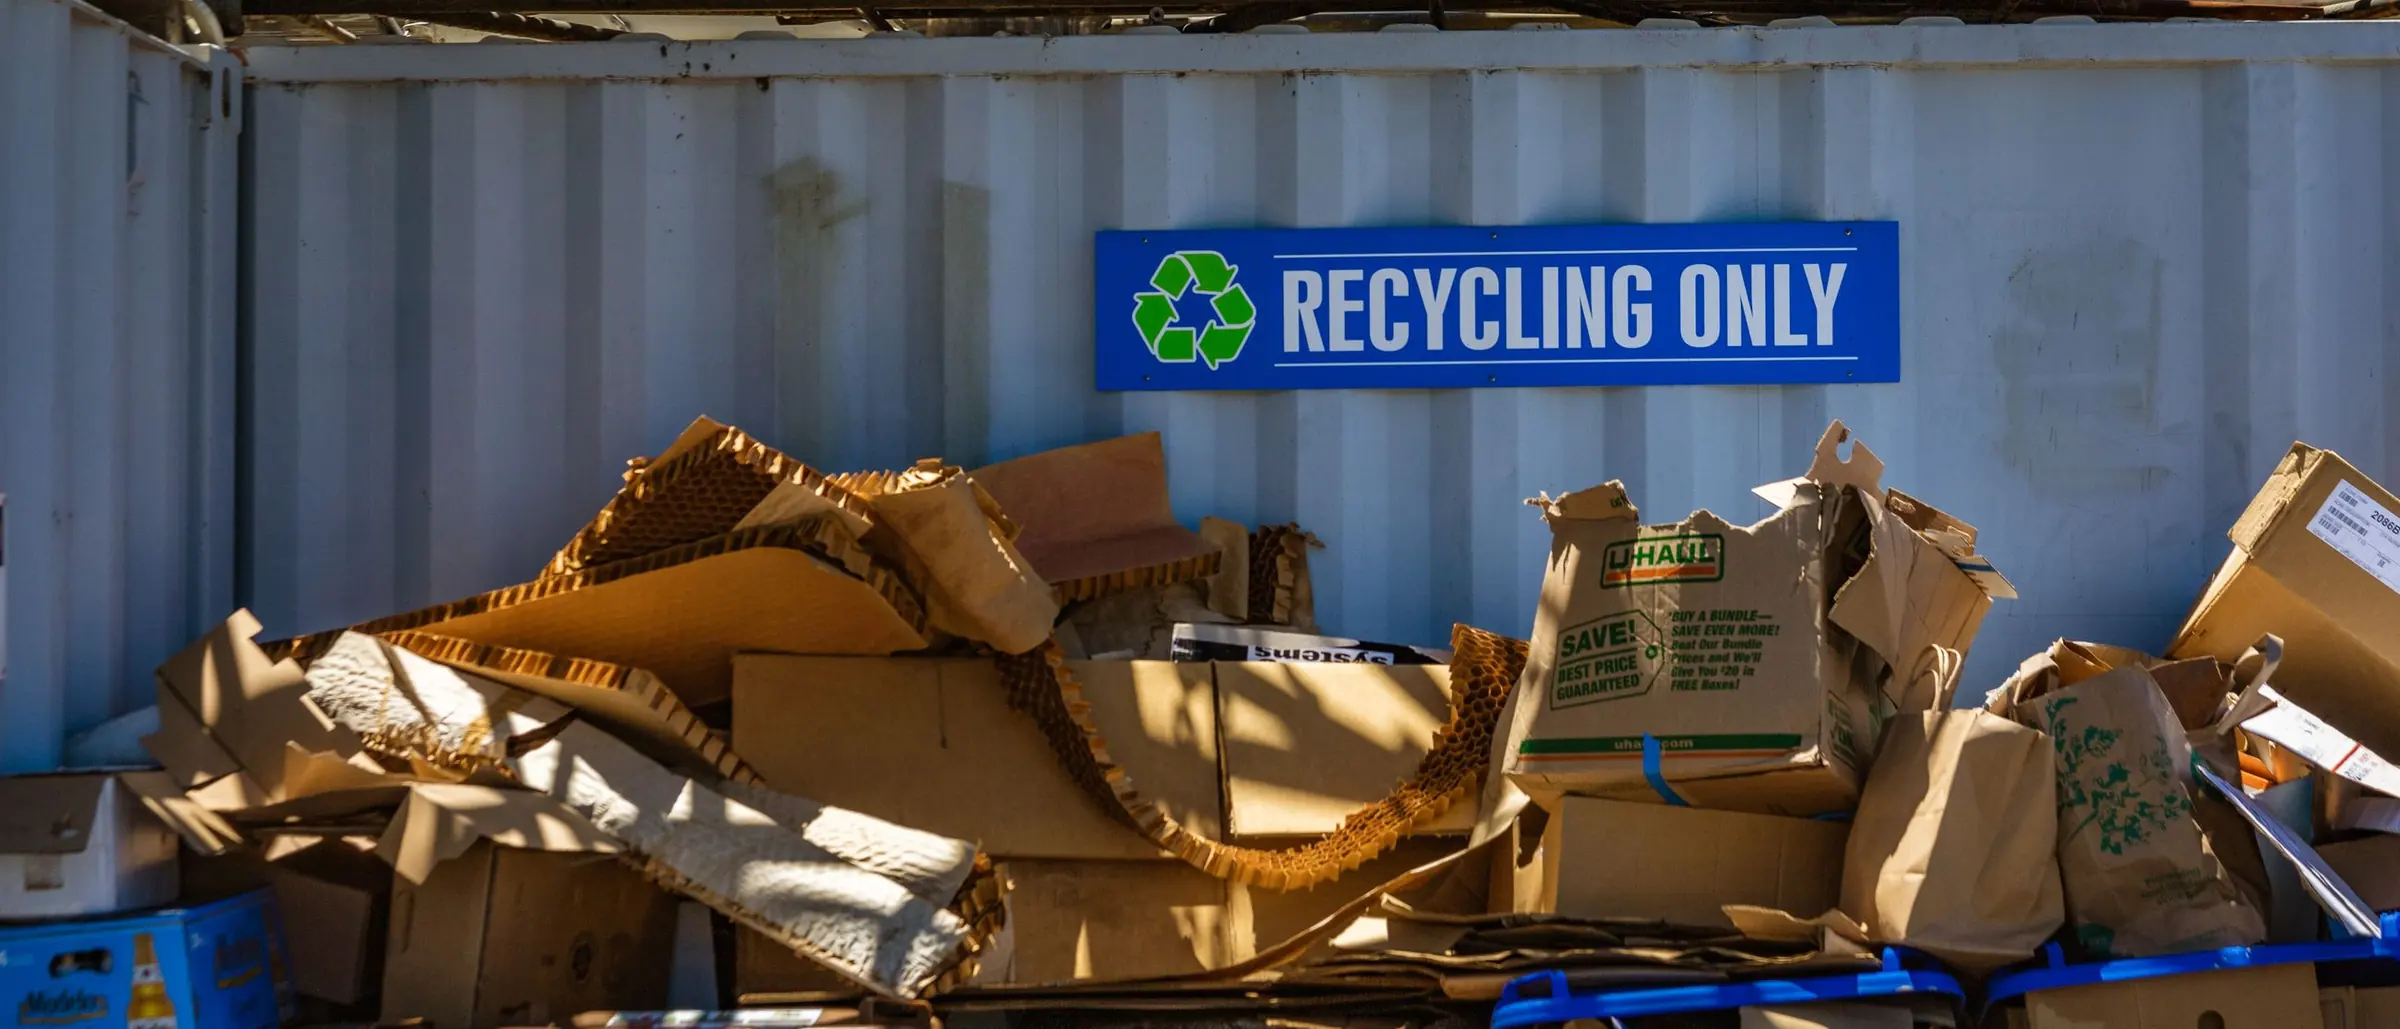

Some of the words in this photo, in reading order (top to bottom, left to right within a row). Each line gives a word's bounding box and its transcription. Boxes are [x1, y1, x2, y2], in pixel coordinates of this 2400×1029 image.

[1283, 264, 1652, 352] RECYCLING
[1680, 262, 1847, 347] ONLY
[1609, 543, 1715, 569] U-HAUL
[1697, 611, 1706, 622] A
[1672, 625, 1701, 637] SAVE
[1704, 625, 1735, 636] EVEN
[1738, 625, 1780, 636] MORE!
[1561, 620, 1636, 658] SAVE!
[1671, 640, 1696, 650] Beat
[1699, 639, 1719, 650] Our
[1722, 639, 1763, 649] Bundle
[1671, 653, 1705, 664] Prices
[1707, 653, 1730, 662] and
[1557, 664, 1590, 685] BEST
[1595, 655, 1637, 676] PRICE
[1671, 667, 1694, 677] Give
[1698, 666, 1718, 677] You
[1743, 666, 1755, 676] in
[1671, 680, 1699, 691] FREE
[1701, 679, 1740, 690] Boxes!
